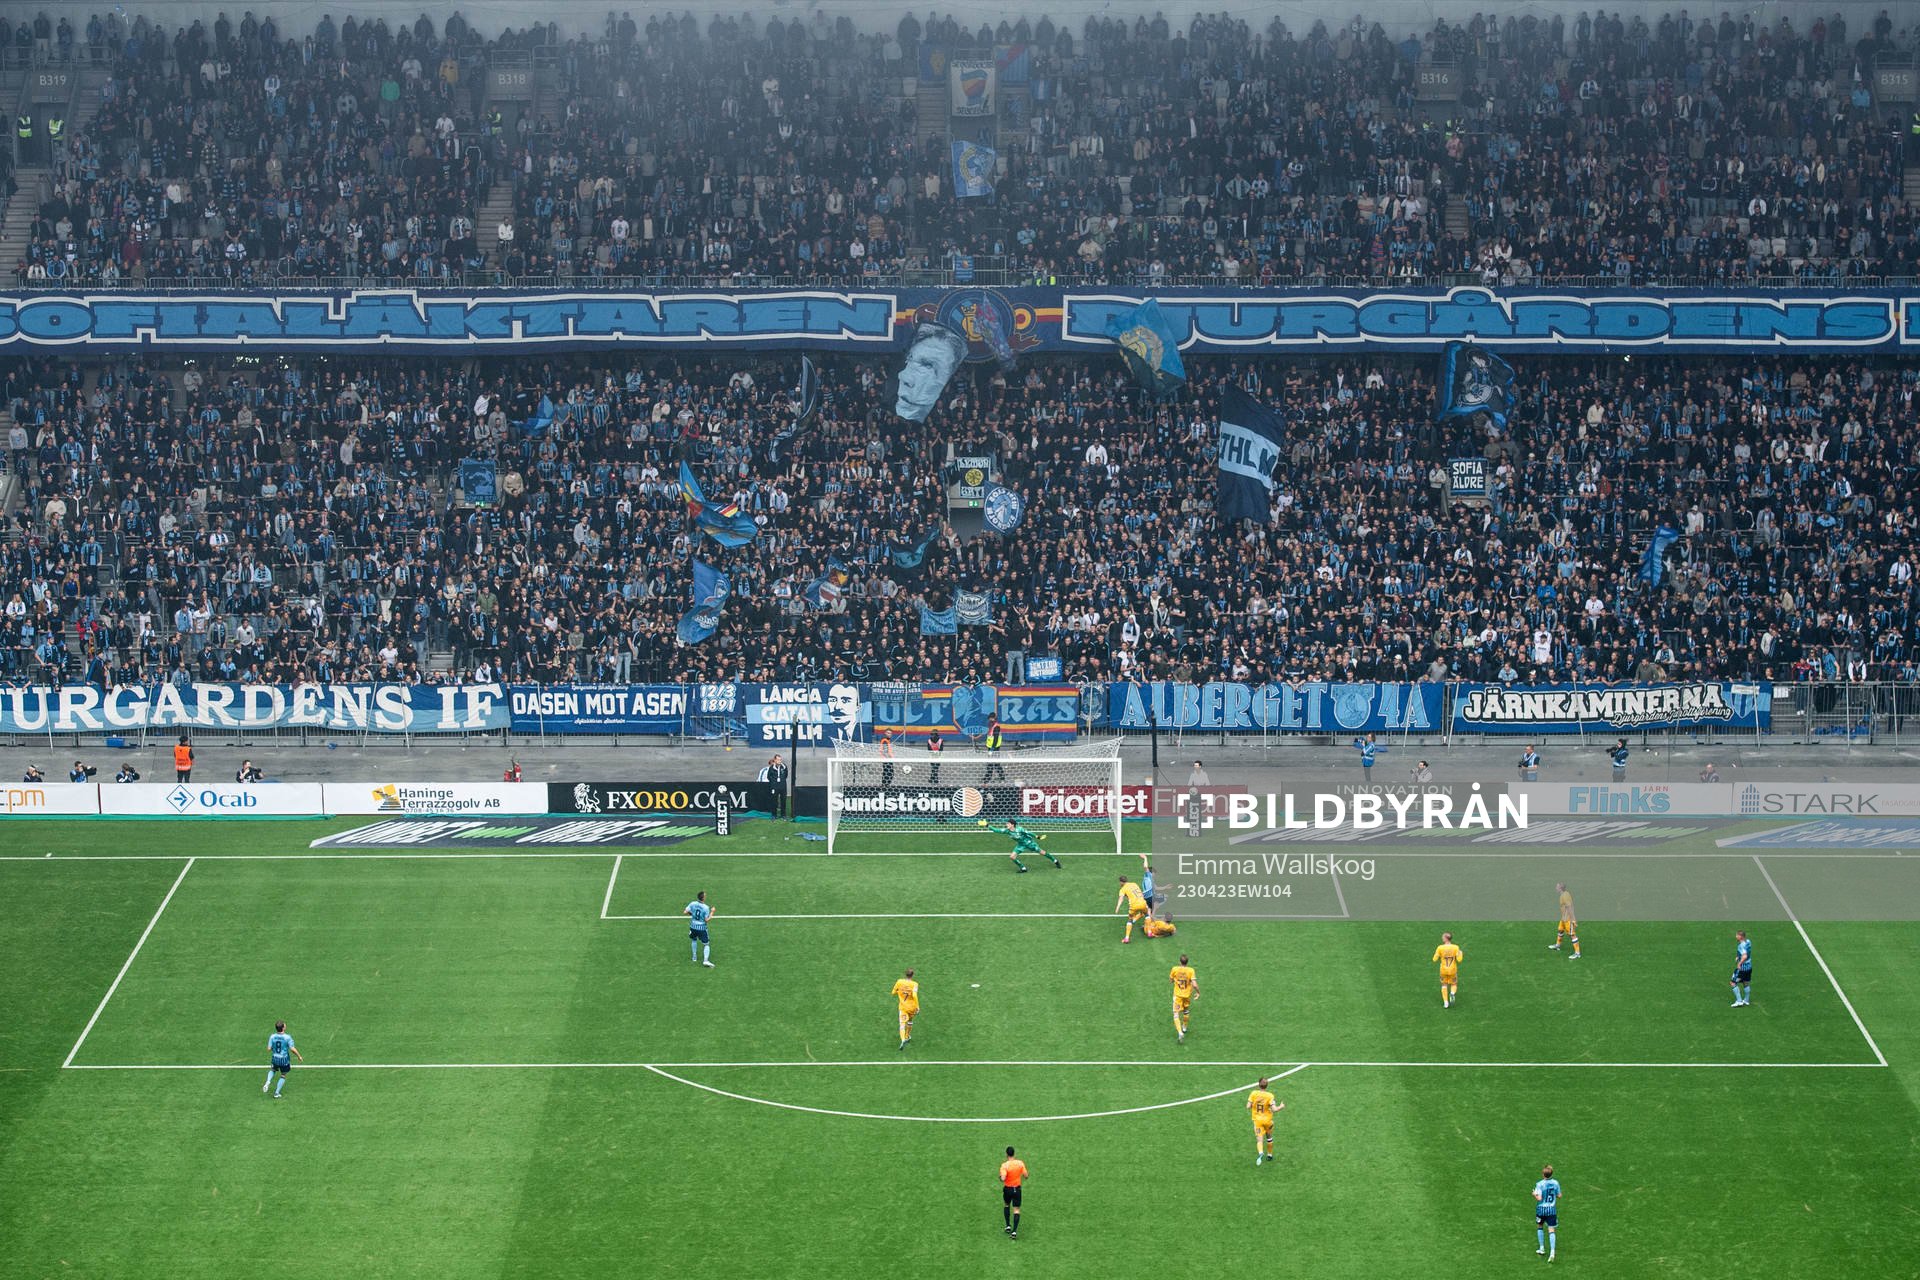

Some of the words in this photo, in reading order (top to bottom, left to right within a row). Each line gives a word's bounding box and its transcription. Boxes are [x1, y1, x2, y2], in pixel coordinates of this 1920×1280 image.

[40, 75, 66, 86] B319
[498, 74, 526, 85] B318
[1421, 73, 1449, 84] B316
[1881, 74, 1908, 85] B315
[0, 289, 897, 345] OFIALÄKTAREN
[1453, 461, 1483, 475] SOFIA
[700, 684, 736, 699] 12/3
[759, 684, 823, 704] LÅNGA
[437, 683, 503, 729] IF
[512, 692, 579, 715] OASEN
[586, 692, 629, 715] MOT
[631, 692, 688, 715] ASEN
[701, 697, 736, 713] 1891
[1120, 682, 1328, 728] ALBERGET
[1377, 682, 1430, 728] 4A
[1464, 684, 1724, 723] JÄRNKAMINERNA
[760, 704, 823, 723] GATAN
[1614, 706, 1668, 727] Djurgårdens
[200, 790, 257, 807] Ocab
[399, 788, 453, 802] Haninge
[1022, 787, 1148, 814] Prioritet
[1336, 785, 1454, 799] INNOVATION
[1568, 787, 1672, 813] Flinks
[400, 799, 479, 815] Terrazzogolv
[484, 801, 500, 812] AB
[831, 791, 952, 812] Sundström
[1762, 793, 1880, 814] STARK
[717, 800, 728, 835] SELECT
[1444, 956, 1455, 967] 17
[902, 991, 909, 1002] 7
[1545, 1188, 1555, 1203] 15
